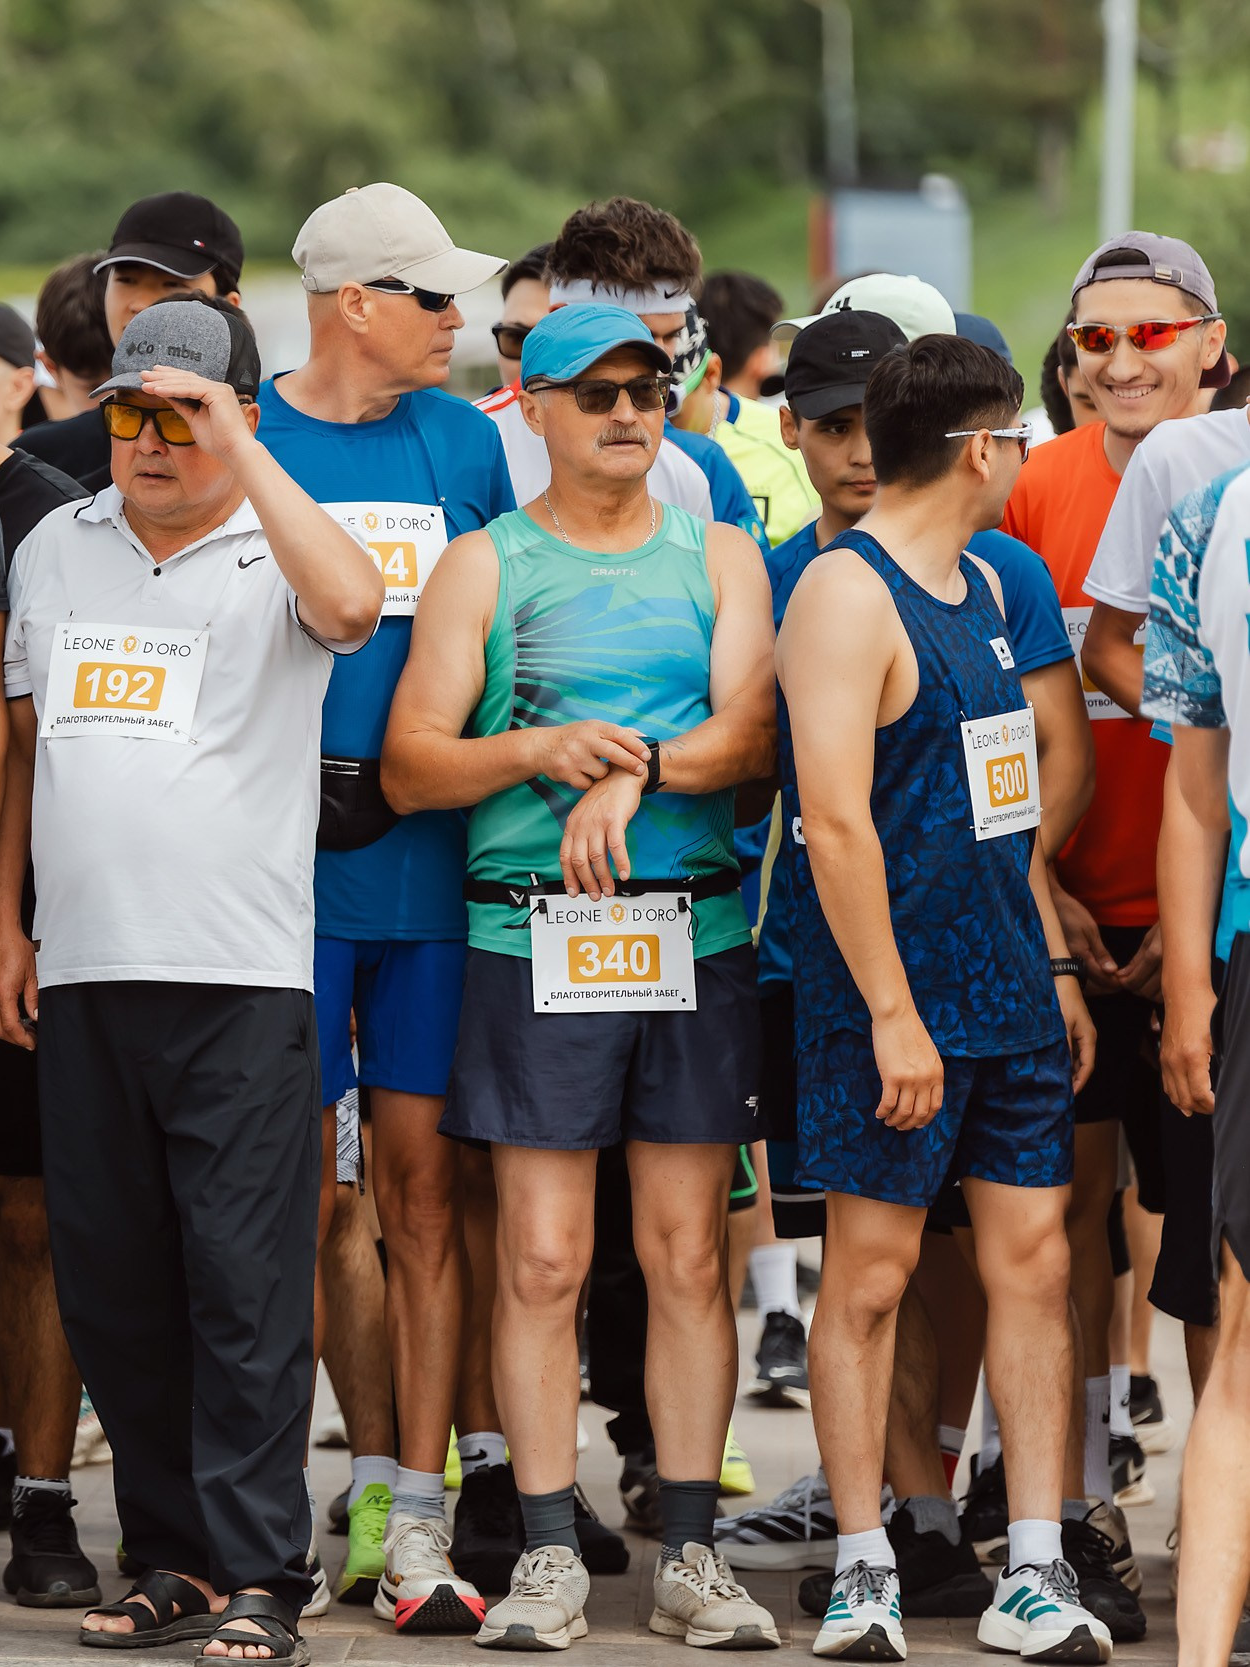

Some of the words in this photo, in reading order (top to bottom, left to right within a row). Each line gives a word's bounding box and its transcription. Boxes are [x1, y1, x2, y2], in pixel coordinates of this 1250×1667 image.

[386, 517, 431, 531] D'ORO
[64, 637, 115, 651] LEONE
[142, 641, 191, 657] D'ORO
[85, 667, 155, 705] 192
[56, 715, 146, 725] БЛАГОТВОРИТЕЛЬНЫЙ
[147, 718, 174, 729] ЗАБЕГ
[972, 732, 1000, 749] LEONE
[992, 759, 1025, 800] 500
[545, 909, 601, 924] LEONE
[632, 909, 677, 922] D'ORO
[578, 941, 650, 977] 340
[550, 988, 653, 1000] БЛАГОТВОРИТЕЛЬНЫЙ
[654, 989, 680, 998] ЗАБЕГ
